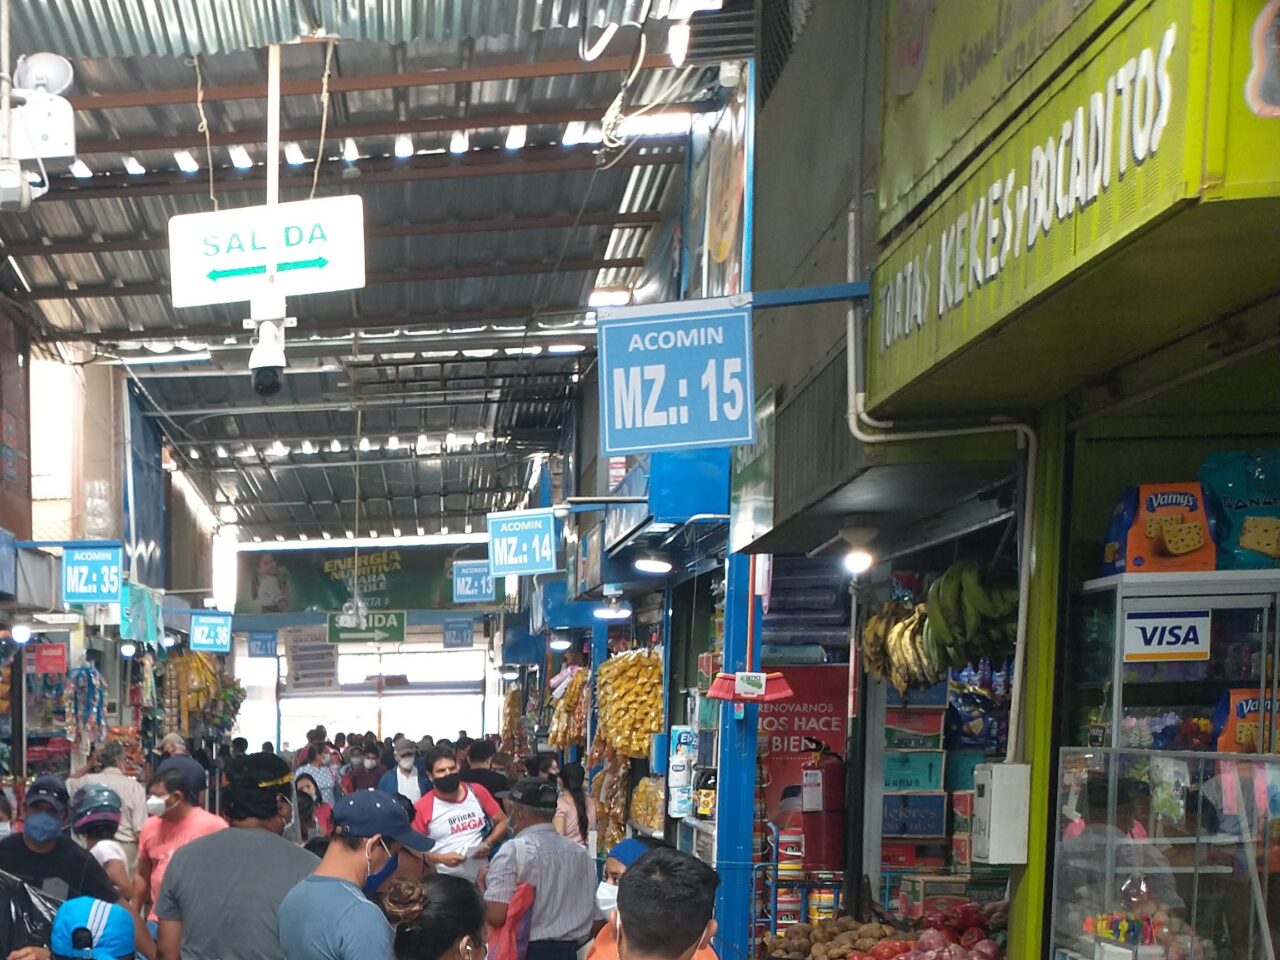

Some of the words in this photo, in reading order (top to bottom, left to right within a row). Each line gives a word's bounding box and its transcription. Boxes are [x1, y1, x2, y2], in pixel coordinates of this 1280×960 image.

[938, 168, 1016, 319] KEKES
[1026, 22, 1177, 248] BOCADITOS
[628, 326, 724, 353] ACOMIN
[613, 364, 689, 430] MZ.:
[701, 357, 744, 422] 15
[1150, 492, 1195, 509] Vamy's
[500, 520, 542, 532] ACOMIN
[73, 551, 112, 562] ACOMIN
[494, 536, 529, 566] MZ.:
[532, 533, 552, 563] 14
[66, 566, 97, 593] MZ.:
[100, 565, 119, 593] 35
[461, 567, 488, 575] ACOMIN
[216, 626, 228, 645] 36
[1135, 625, 1200, 646] VISA
[758, 702, 834, 714] RENOVARNOS
[794, 716, 842, 732] HACE
[450, 817, 484, 836] MEGA
